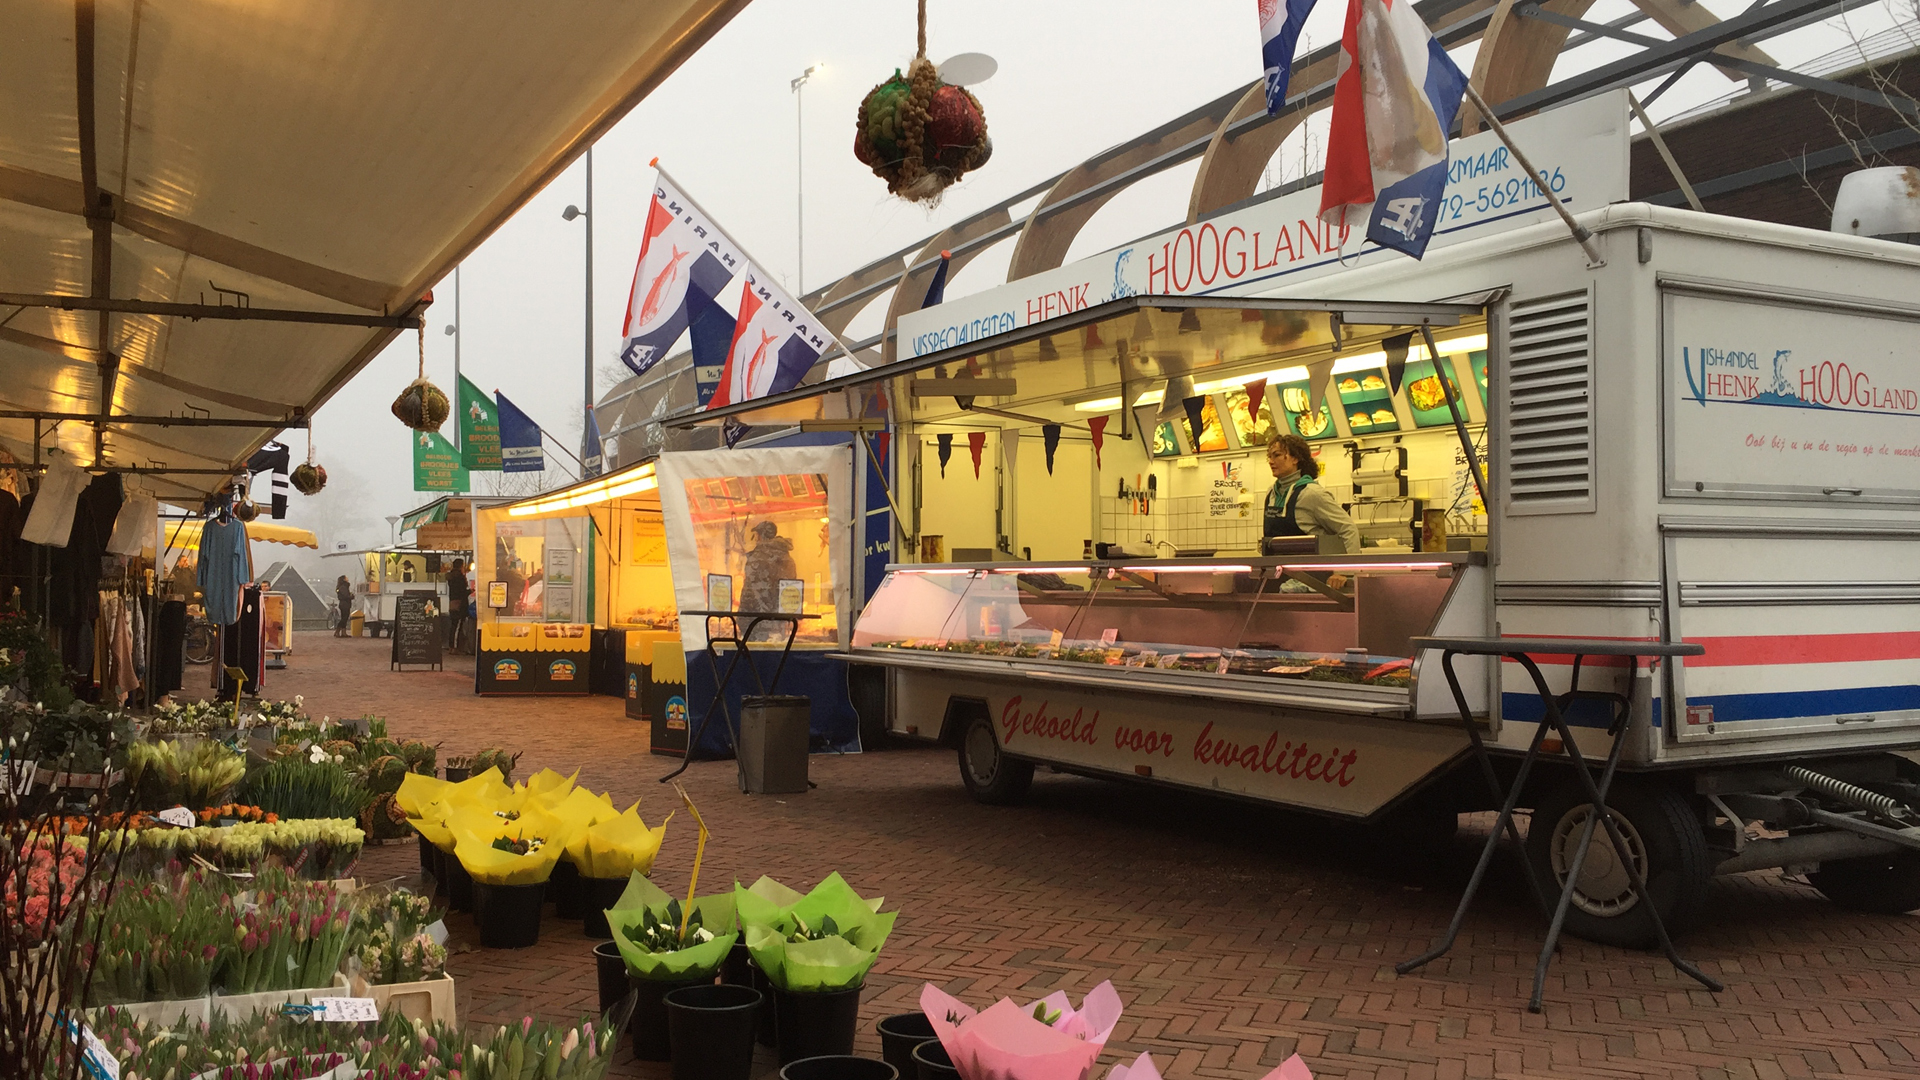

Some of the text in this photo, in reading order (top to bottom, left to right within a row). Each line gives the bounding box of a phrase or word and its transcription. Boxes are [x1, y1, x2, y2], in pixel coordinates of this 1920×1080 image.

[1026, 282, 1090, 327] HENK
[1147, 215, 1350, 296] HOOGLAND
[1707, 360, 1919, 411] HENK HOOGLAND
[1772, 435, 1786, 452] bij
[1791, 441, 1798, 450] u
[1803, 440, 1813, 450] in
[1818, 440, 1830, 451] de
[1836, 443, 1858, 456] regio
[1863, 444, 1874, 457] op
[1879, 444, 1889, 455] de
[1001, 695, 1358, 787] Gekoeld voor kwaliteit
